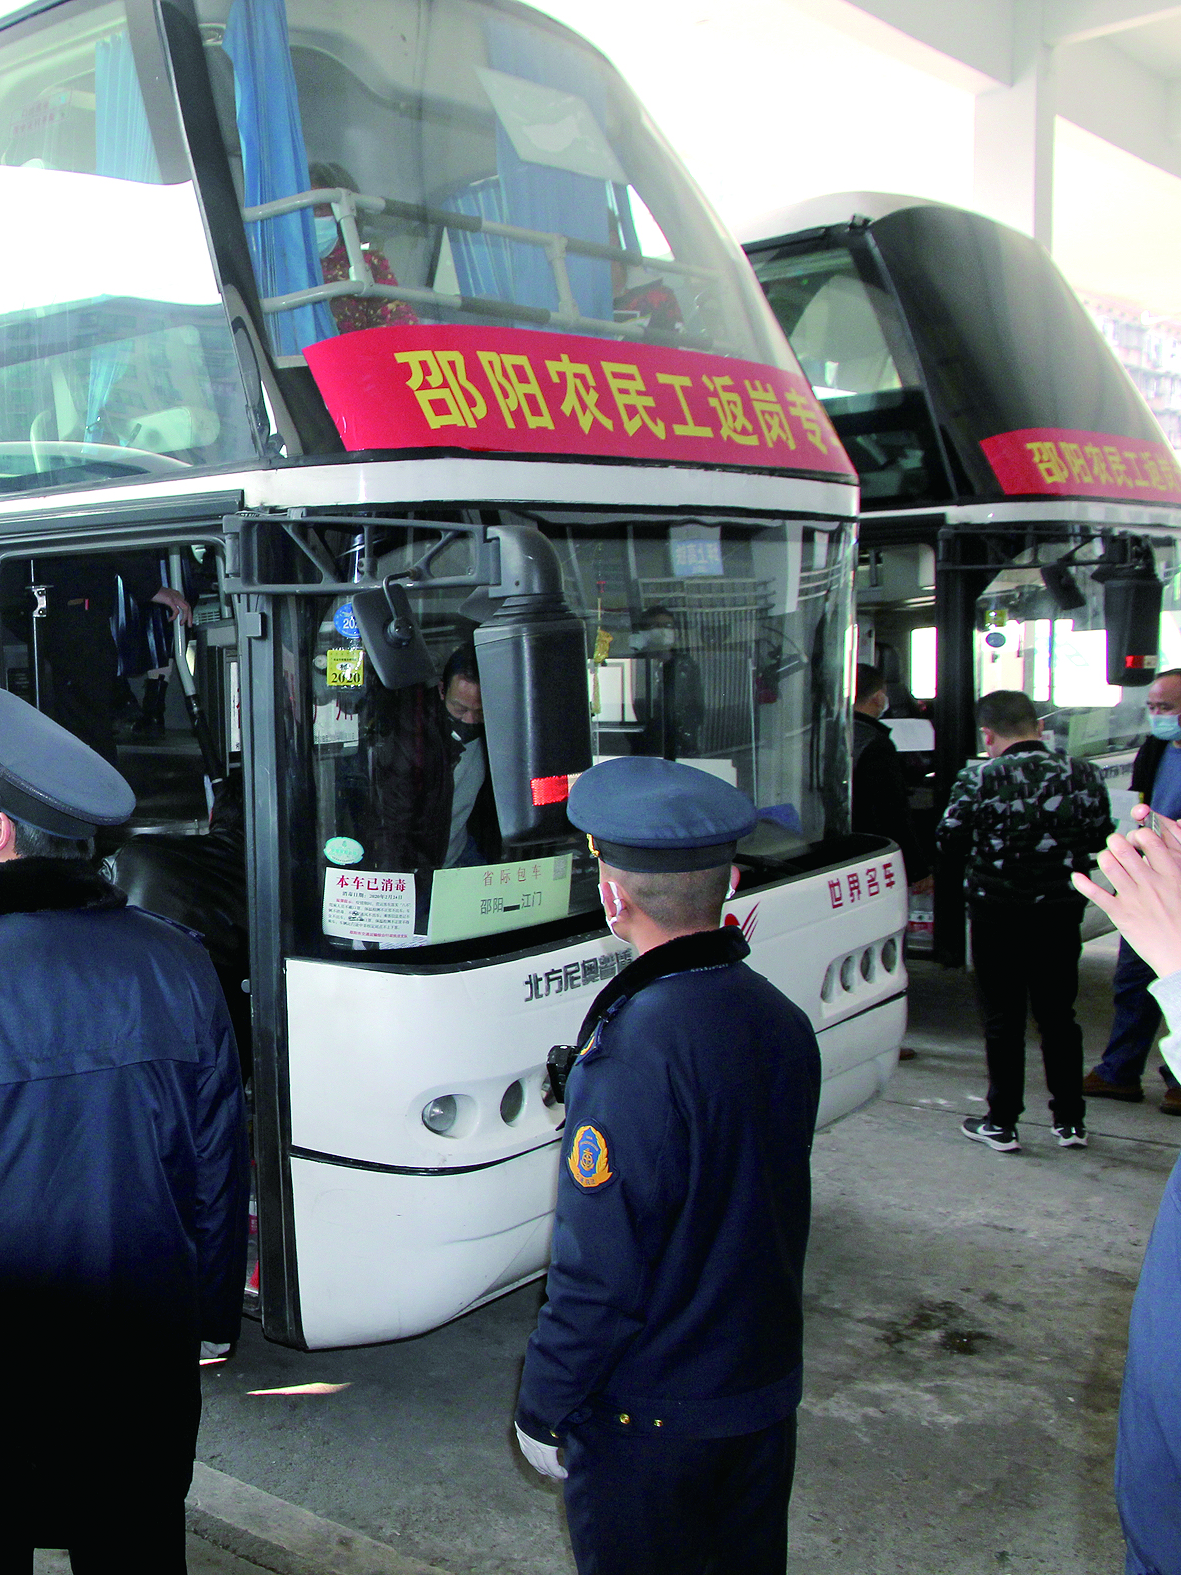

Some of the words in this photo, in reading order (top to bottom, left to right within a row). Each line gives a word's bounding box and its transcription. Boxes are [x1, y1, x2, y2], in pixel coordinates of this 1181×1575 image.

[394, 349, 837, 456] 邵阳农民工返岗专
[336, 874, 407, 893] 本车已消毒
[483, 864, 542, 887] 省际包车
[828, 862, 896, 909] 世界名车
